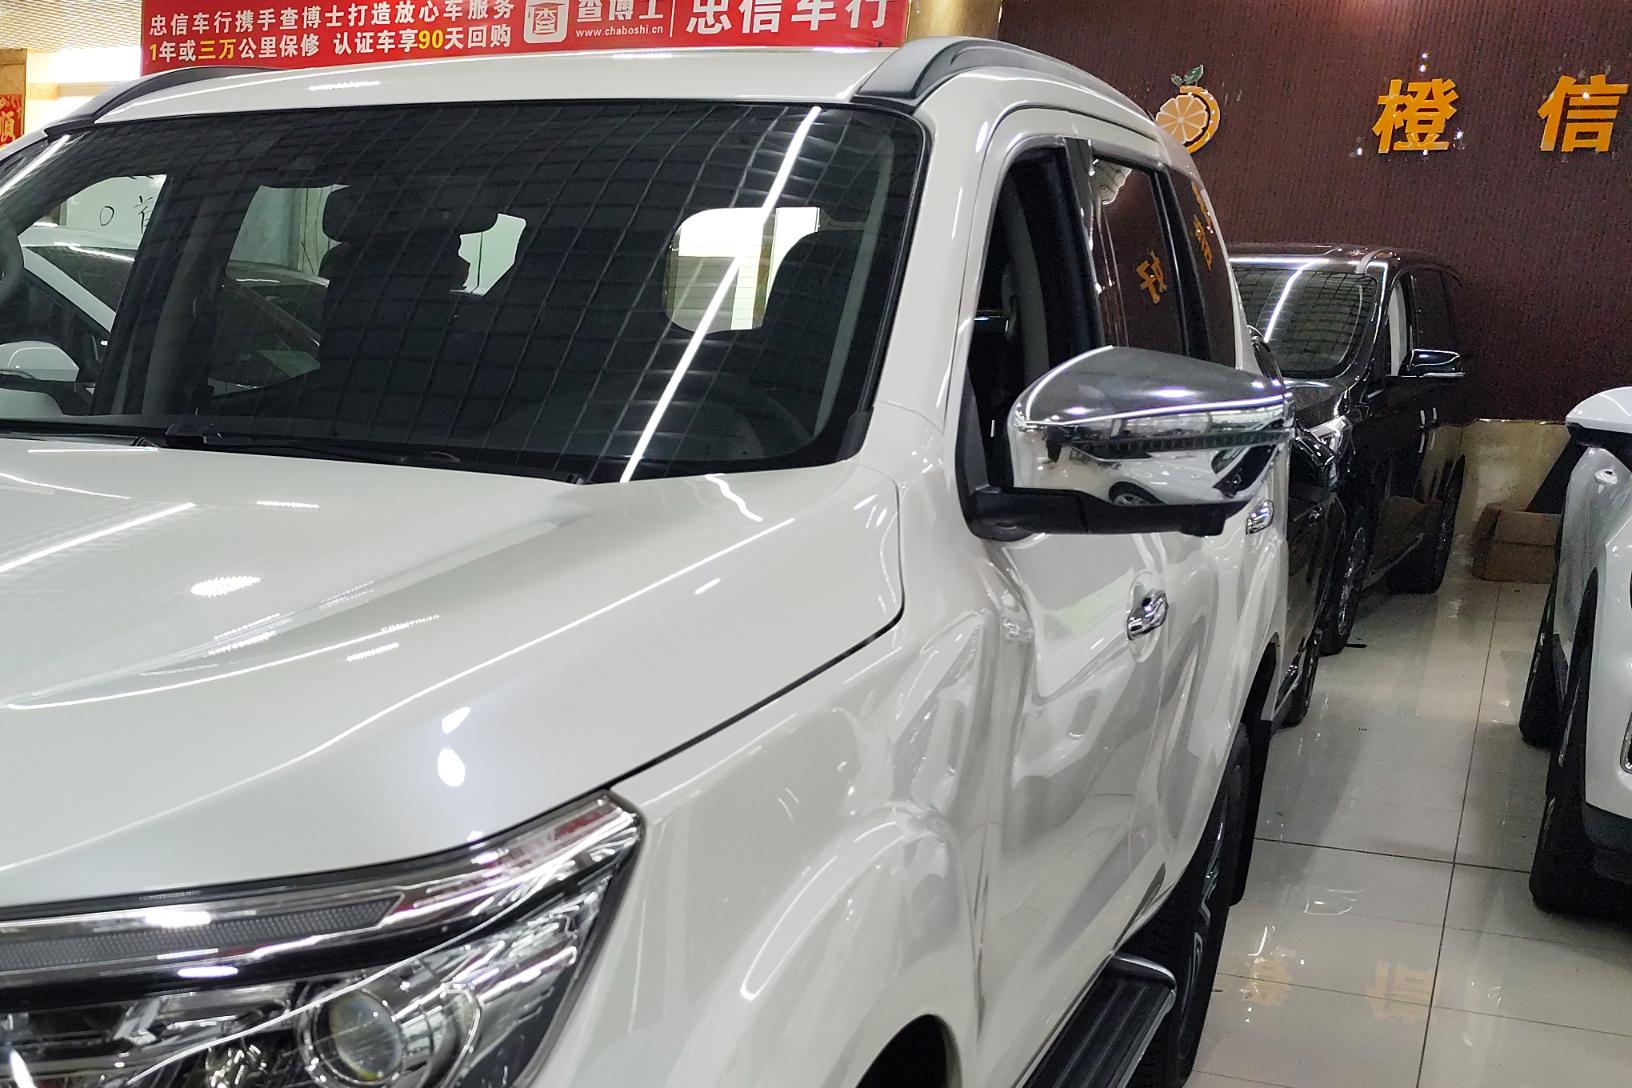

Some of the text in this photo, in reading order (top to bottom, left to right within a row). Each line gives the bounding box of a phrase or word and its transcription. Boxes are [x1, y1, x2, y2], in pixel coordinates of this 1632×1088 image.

[149, 0, 515, 36] 忠信车行携手查博士打造放心车服务
[575, 25, 664, 37] www.chaboshi.cn
[686, 0, 890, 34] 忠信车行
[149, 25, 512, 62] 1年或三万公里保修 认证车享90天回购
